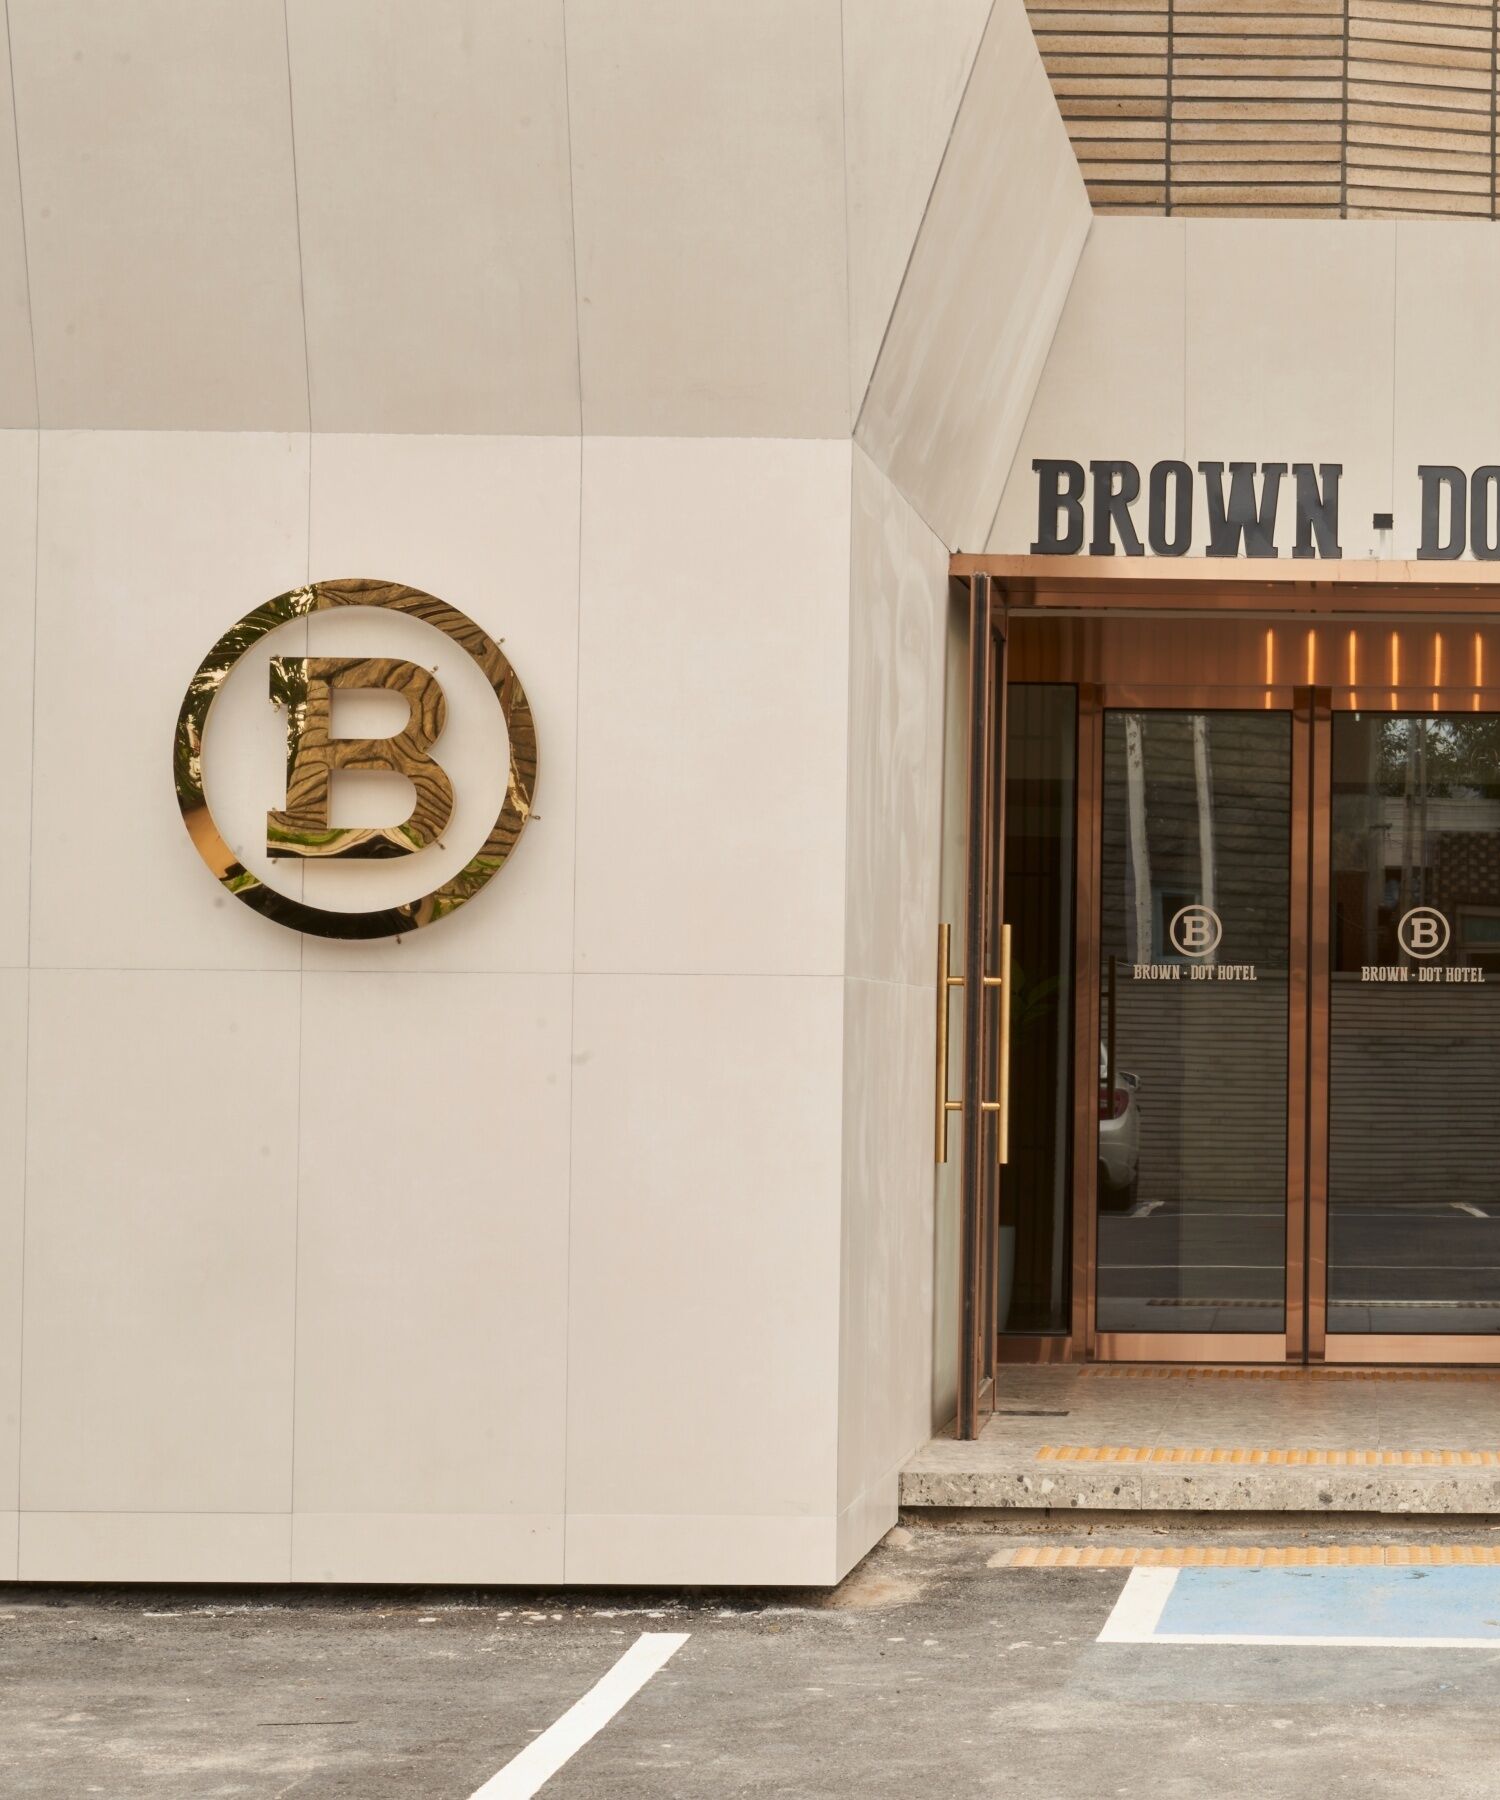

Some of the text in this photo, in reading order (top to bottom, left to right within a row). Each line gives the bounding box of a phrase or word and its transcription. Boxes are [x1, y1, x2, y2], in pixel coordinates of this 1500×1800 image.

[1030, 459, 1343, 559] BROWN
[267, 656, 456, 859] B
[1182, 916, 1210, 946] B
[1410, 918, 1439, 948] B
[1133, 964, 1180, 980] BROWN
[1191, 964, 1215, 980] DOT
[1217, 965, 1257, 980] HOTEL
[1361, 966, 1408, 981] BROWN
[1418, 967, 1442, 982] DOT
[1445, 967, 1485, 982] HOTEL
